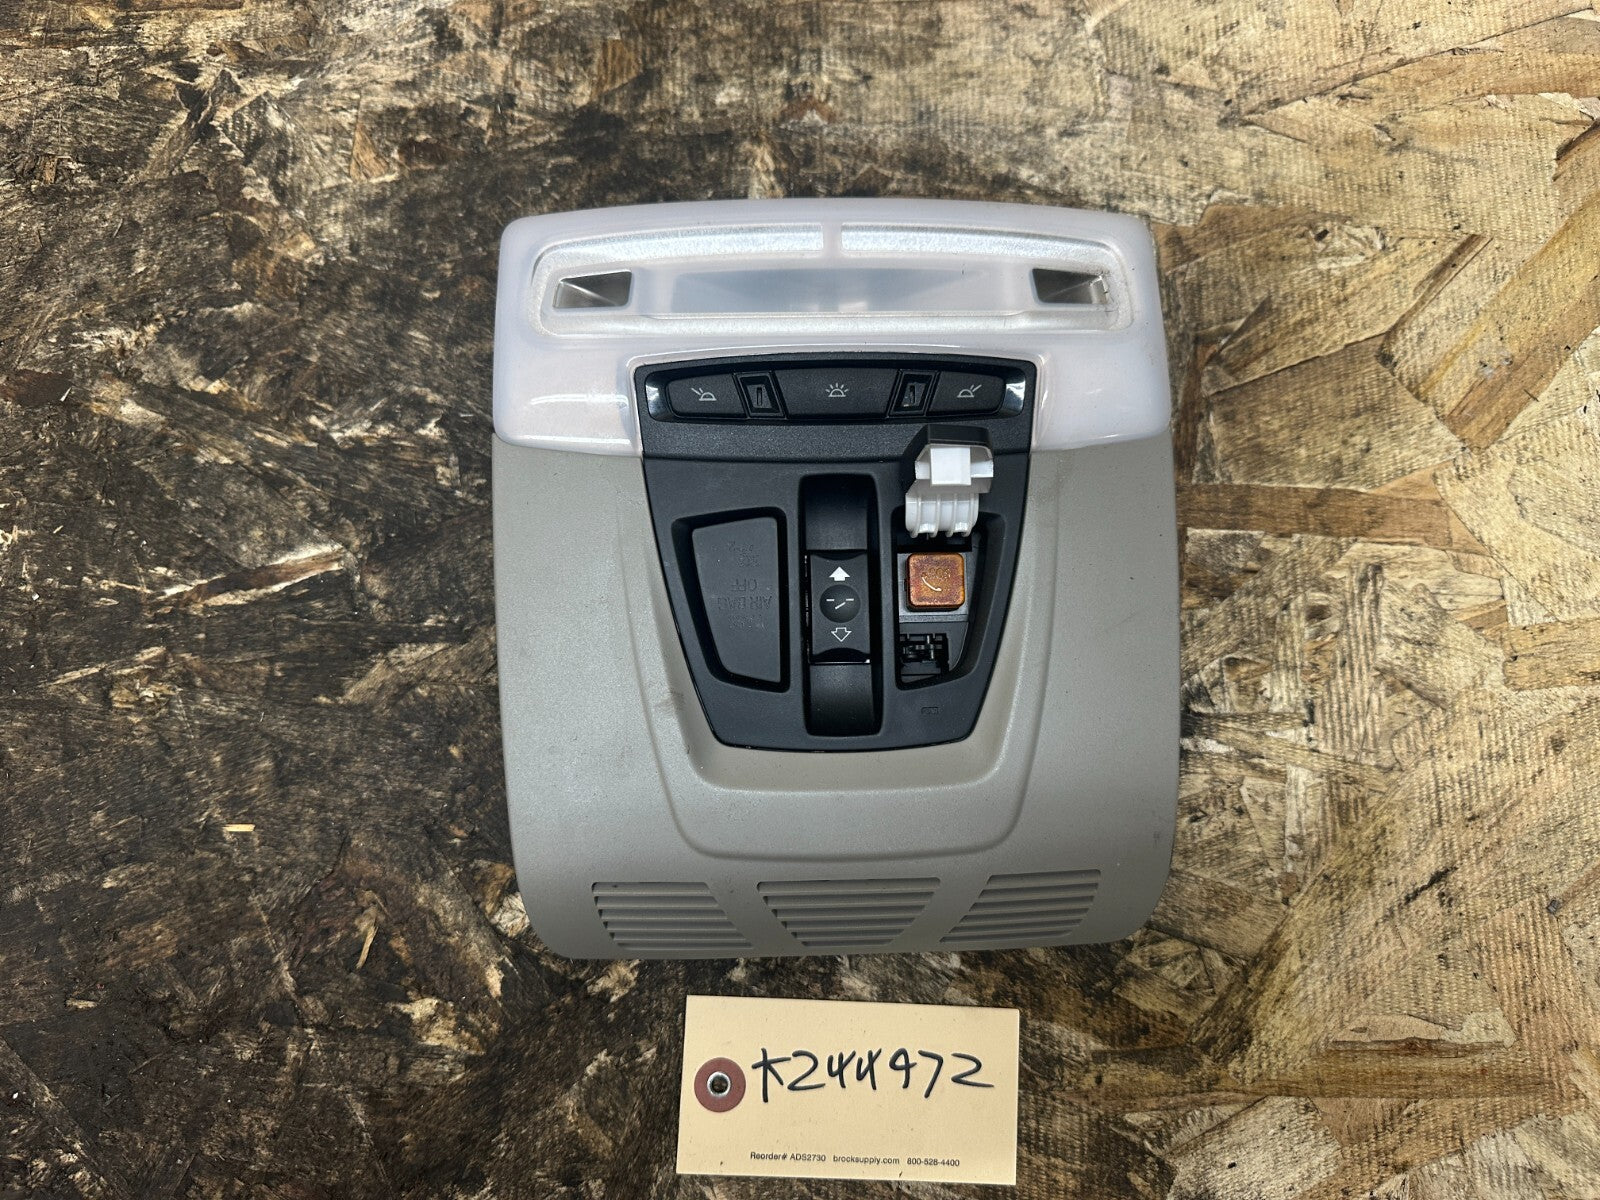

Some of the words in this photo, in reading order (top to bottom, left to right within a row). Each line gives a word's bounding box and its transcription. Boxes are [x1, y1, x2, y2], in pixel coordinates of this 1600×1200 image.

[730, 578, 758, 592] OFF
[751, 1047, 994, 1103] K244972
[750, 1152, 787, 1161] Reorder#
[790, 1153, 826, 1162] ADS2730
[833, 1155, 900, 1165] brocksupply.com
[907, 1158, 960, 1167] 800-528-4400
